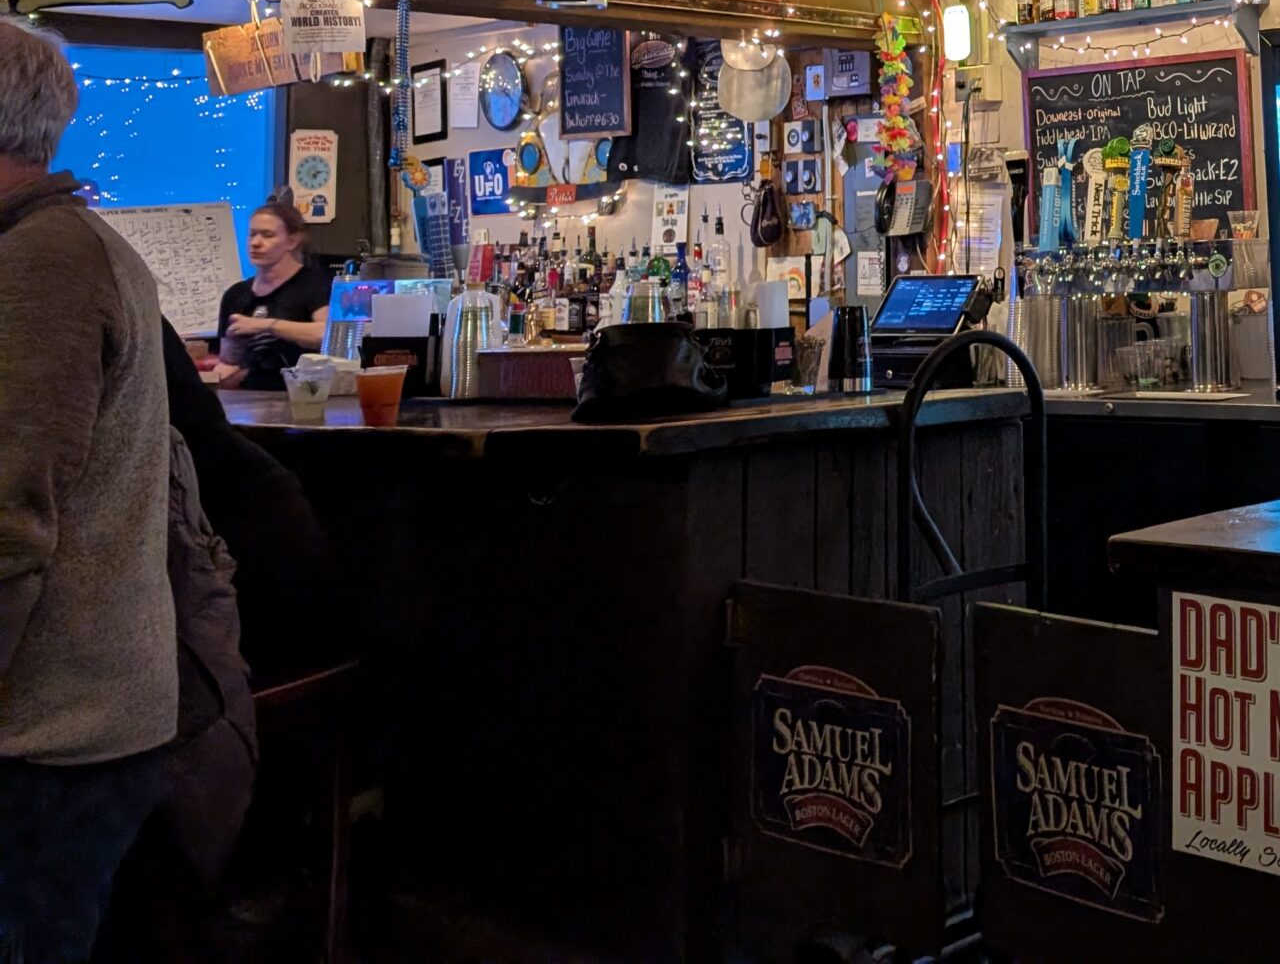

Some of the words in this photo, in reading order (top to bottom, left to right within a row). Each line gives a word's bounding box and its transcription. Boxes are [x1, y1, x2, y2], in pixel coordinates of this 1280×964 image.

[291, 16, 320, 27] WORLD
[322, 15, 362, 27] HISTORY!
[1091, 73, 1112, 98] ON
[1116, 68, 1147, 93] TAP
[1146, 96, 1172, 119] Bud
[1177, 94, 1209, 123] Light
[474, 173, 503, 197] UFO
[1131, 151, 1144, 196] Switchback
[1094, 182, 1103, 207] Next
[1090, 210, 1101, 237] Trick
[1180, 674, 1256, 756] HOT
[773, 707, 892, 776] SAMUEL
[779, 752, 882, 814] ADAMS
[1016, 740, 1142, 820] SAMUEL
[795, 805, 830, 821] BOSTON
[831, 807, 862, 837] LAGER
[1026, 790, 1133, 862] ADAMS
[1185, 829, 1251, 864] Locally
[1043, 849, 1079, 865] BOSTON
[1081, 851, 1112, 886] LAGER
